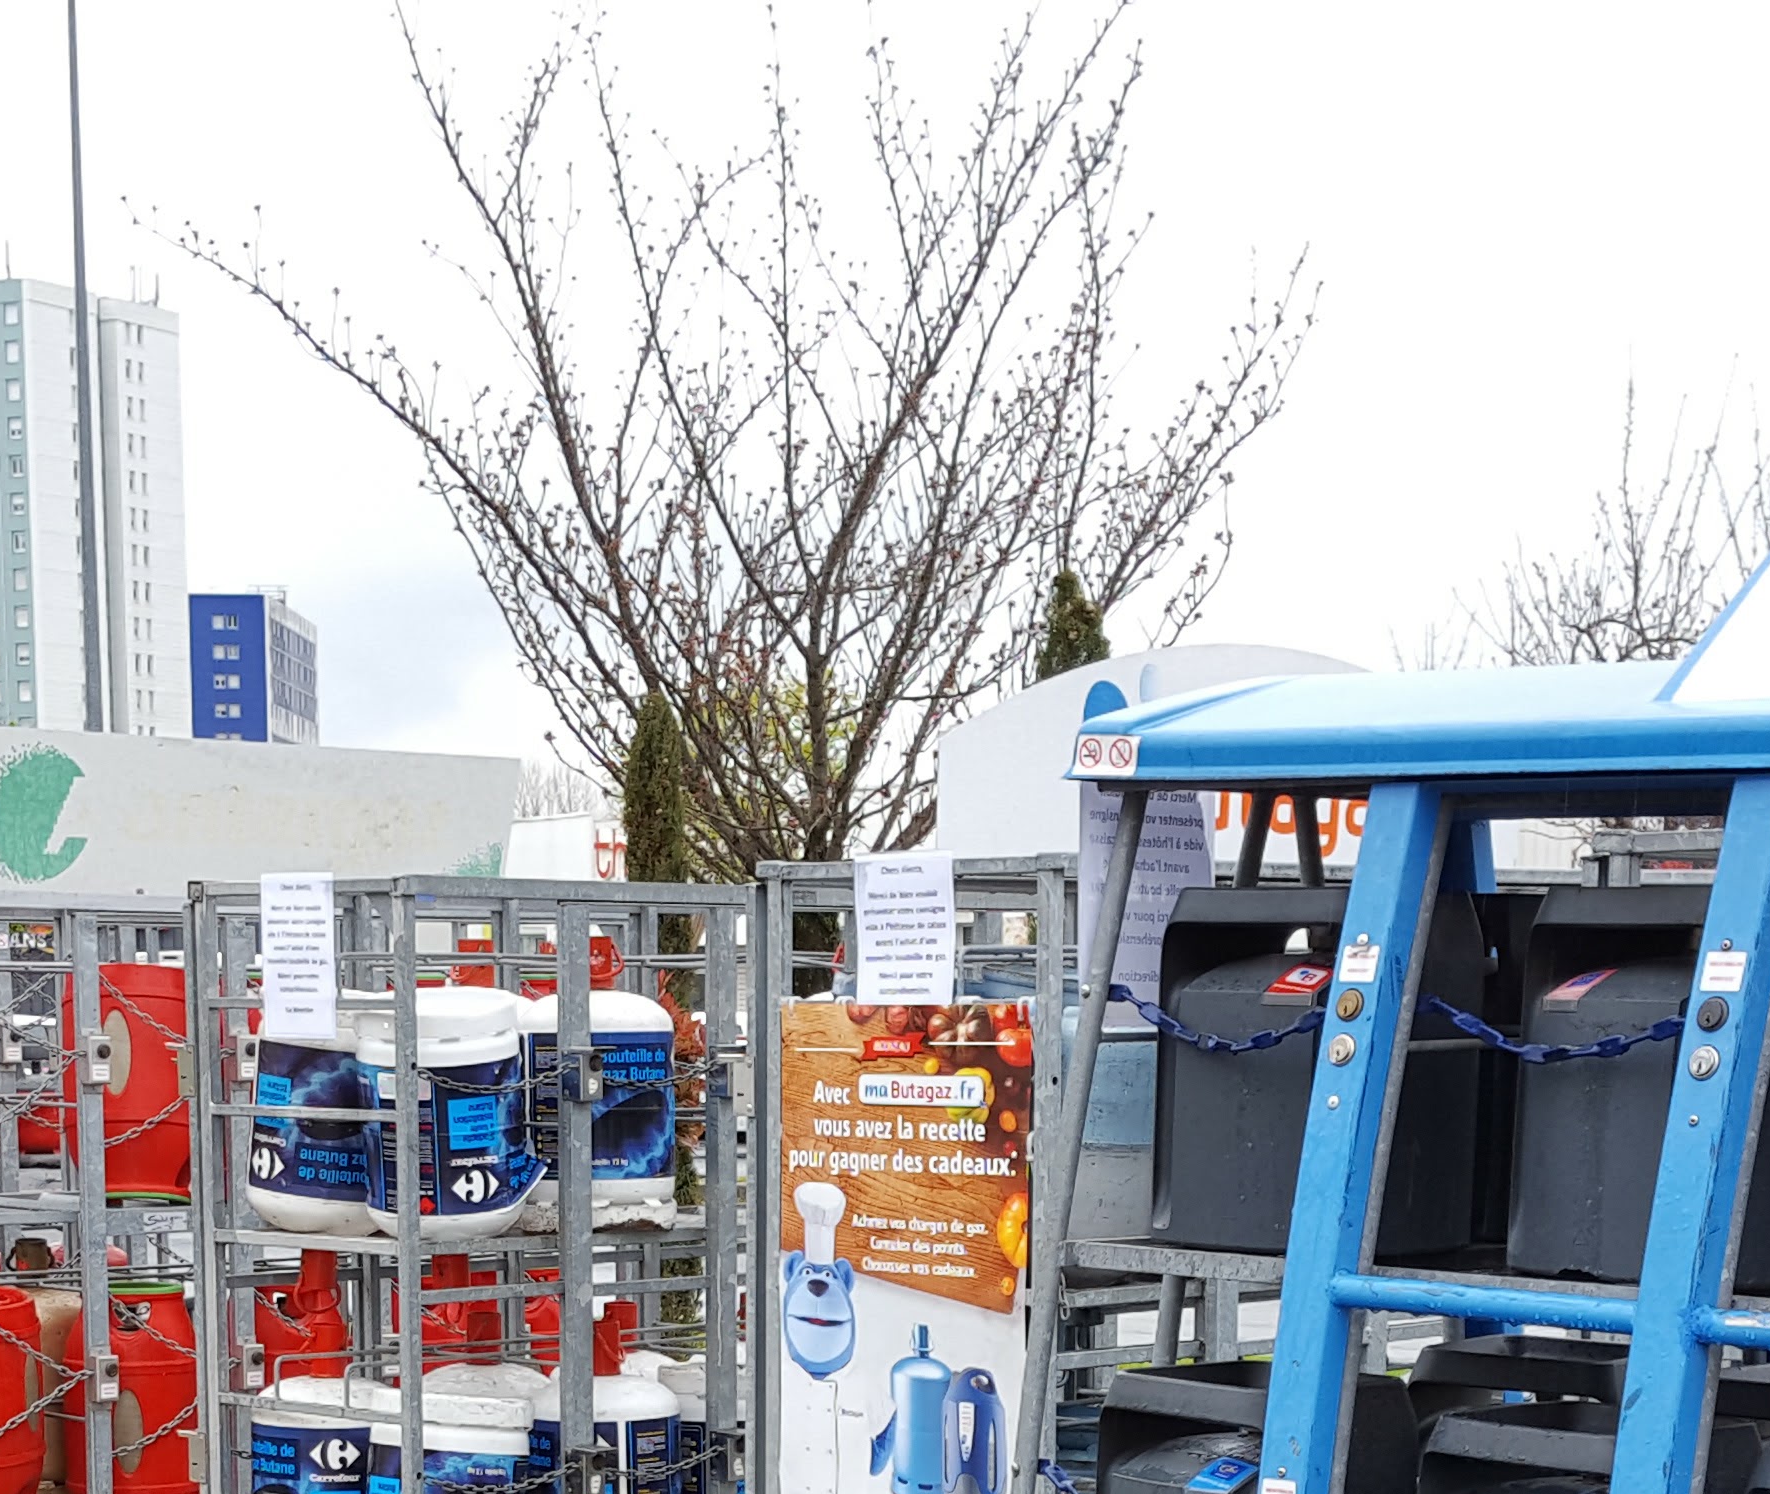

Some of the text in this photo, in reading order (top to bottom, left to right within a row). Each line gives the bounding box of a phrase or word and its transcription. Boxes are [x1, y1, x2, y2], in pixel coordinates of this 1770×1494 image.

[813, 1079, 851, 1105] Avec
[814, 1114, 986, 1143] vous avez la recette
[300, 1147, 350, 1167] Butane
[788, 1149, 826, 1173] pour
[829, 1151, 888, 1176] gagner
[892, 1147, 924, 1173] des
[298, 1165, 316, 1181] de
[280, 1443, 296, 1458] de
[309, 1473, 361, 1483] Carrefour
